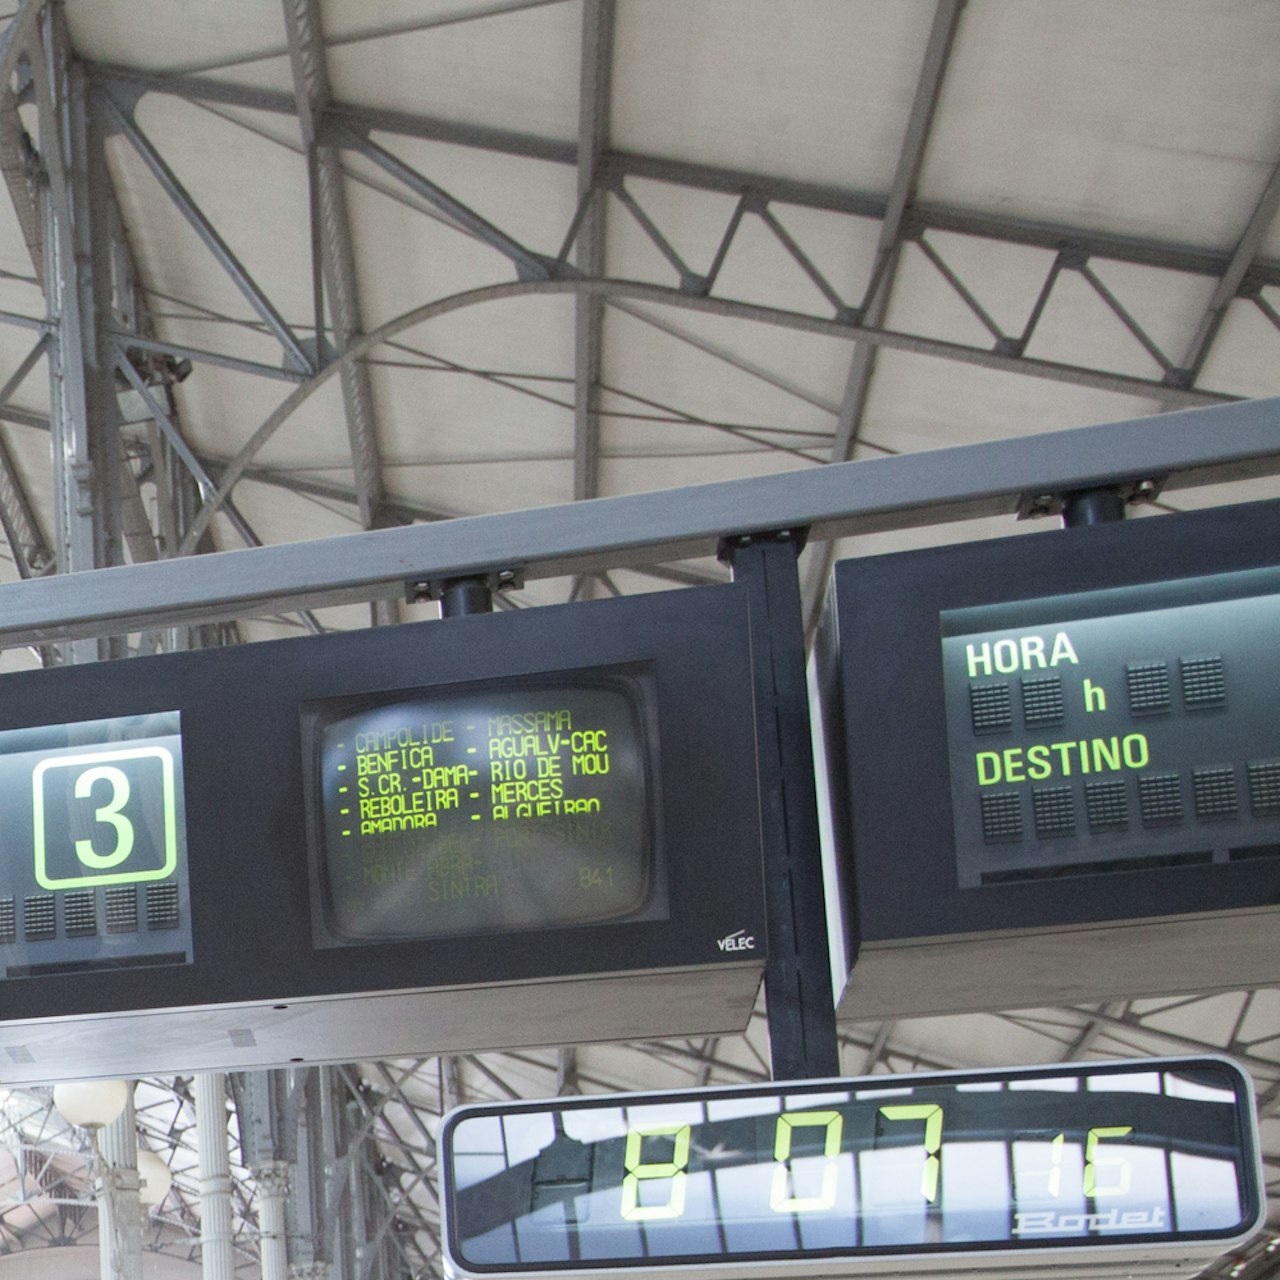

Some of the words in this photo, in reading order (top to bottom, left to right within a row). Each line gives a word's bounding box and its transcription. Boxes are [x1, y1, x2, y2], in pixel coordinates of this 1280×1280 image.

[966, 632, 1079, 677] HORA
[1083, 679, 1106, 712] h
[356, 721, 454, 754] CAMPOLIDE
[488, 710, 572, 735] MASSAMA
[489, 730, 608, 759] AGUALV-CAC
[976, 733, 1149, 785] DESTINO
[357, 747, 433, 776] BENFICA
[490, 758, 525, 782] RIO
[538, 756, 561, 778] DE
[571, 754, 610, 776] MOU
[360, 788, 459, 820] REBOLEIRA
[491, 779, 563, 804] MERCES
[73, 766, 135, 869] 3
[717, 935, 755, 951] VELEC
[621, 1123, 691, 1221] 8
[770, 1104, 943, 1212] 07
[1012, 1206, 1166, 1234] Bodet
